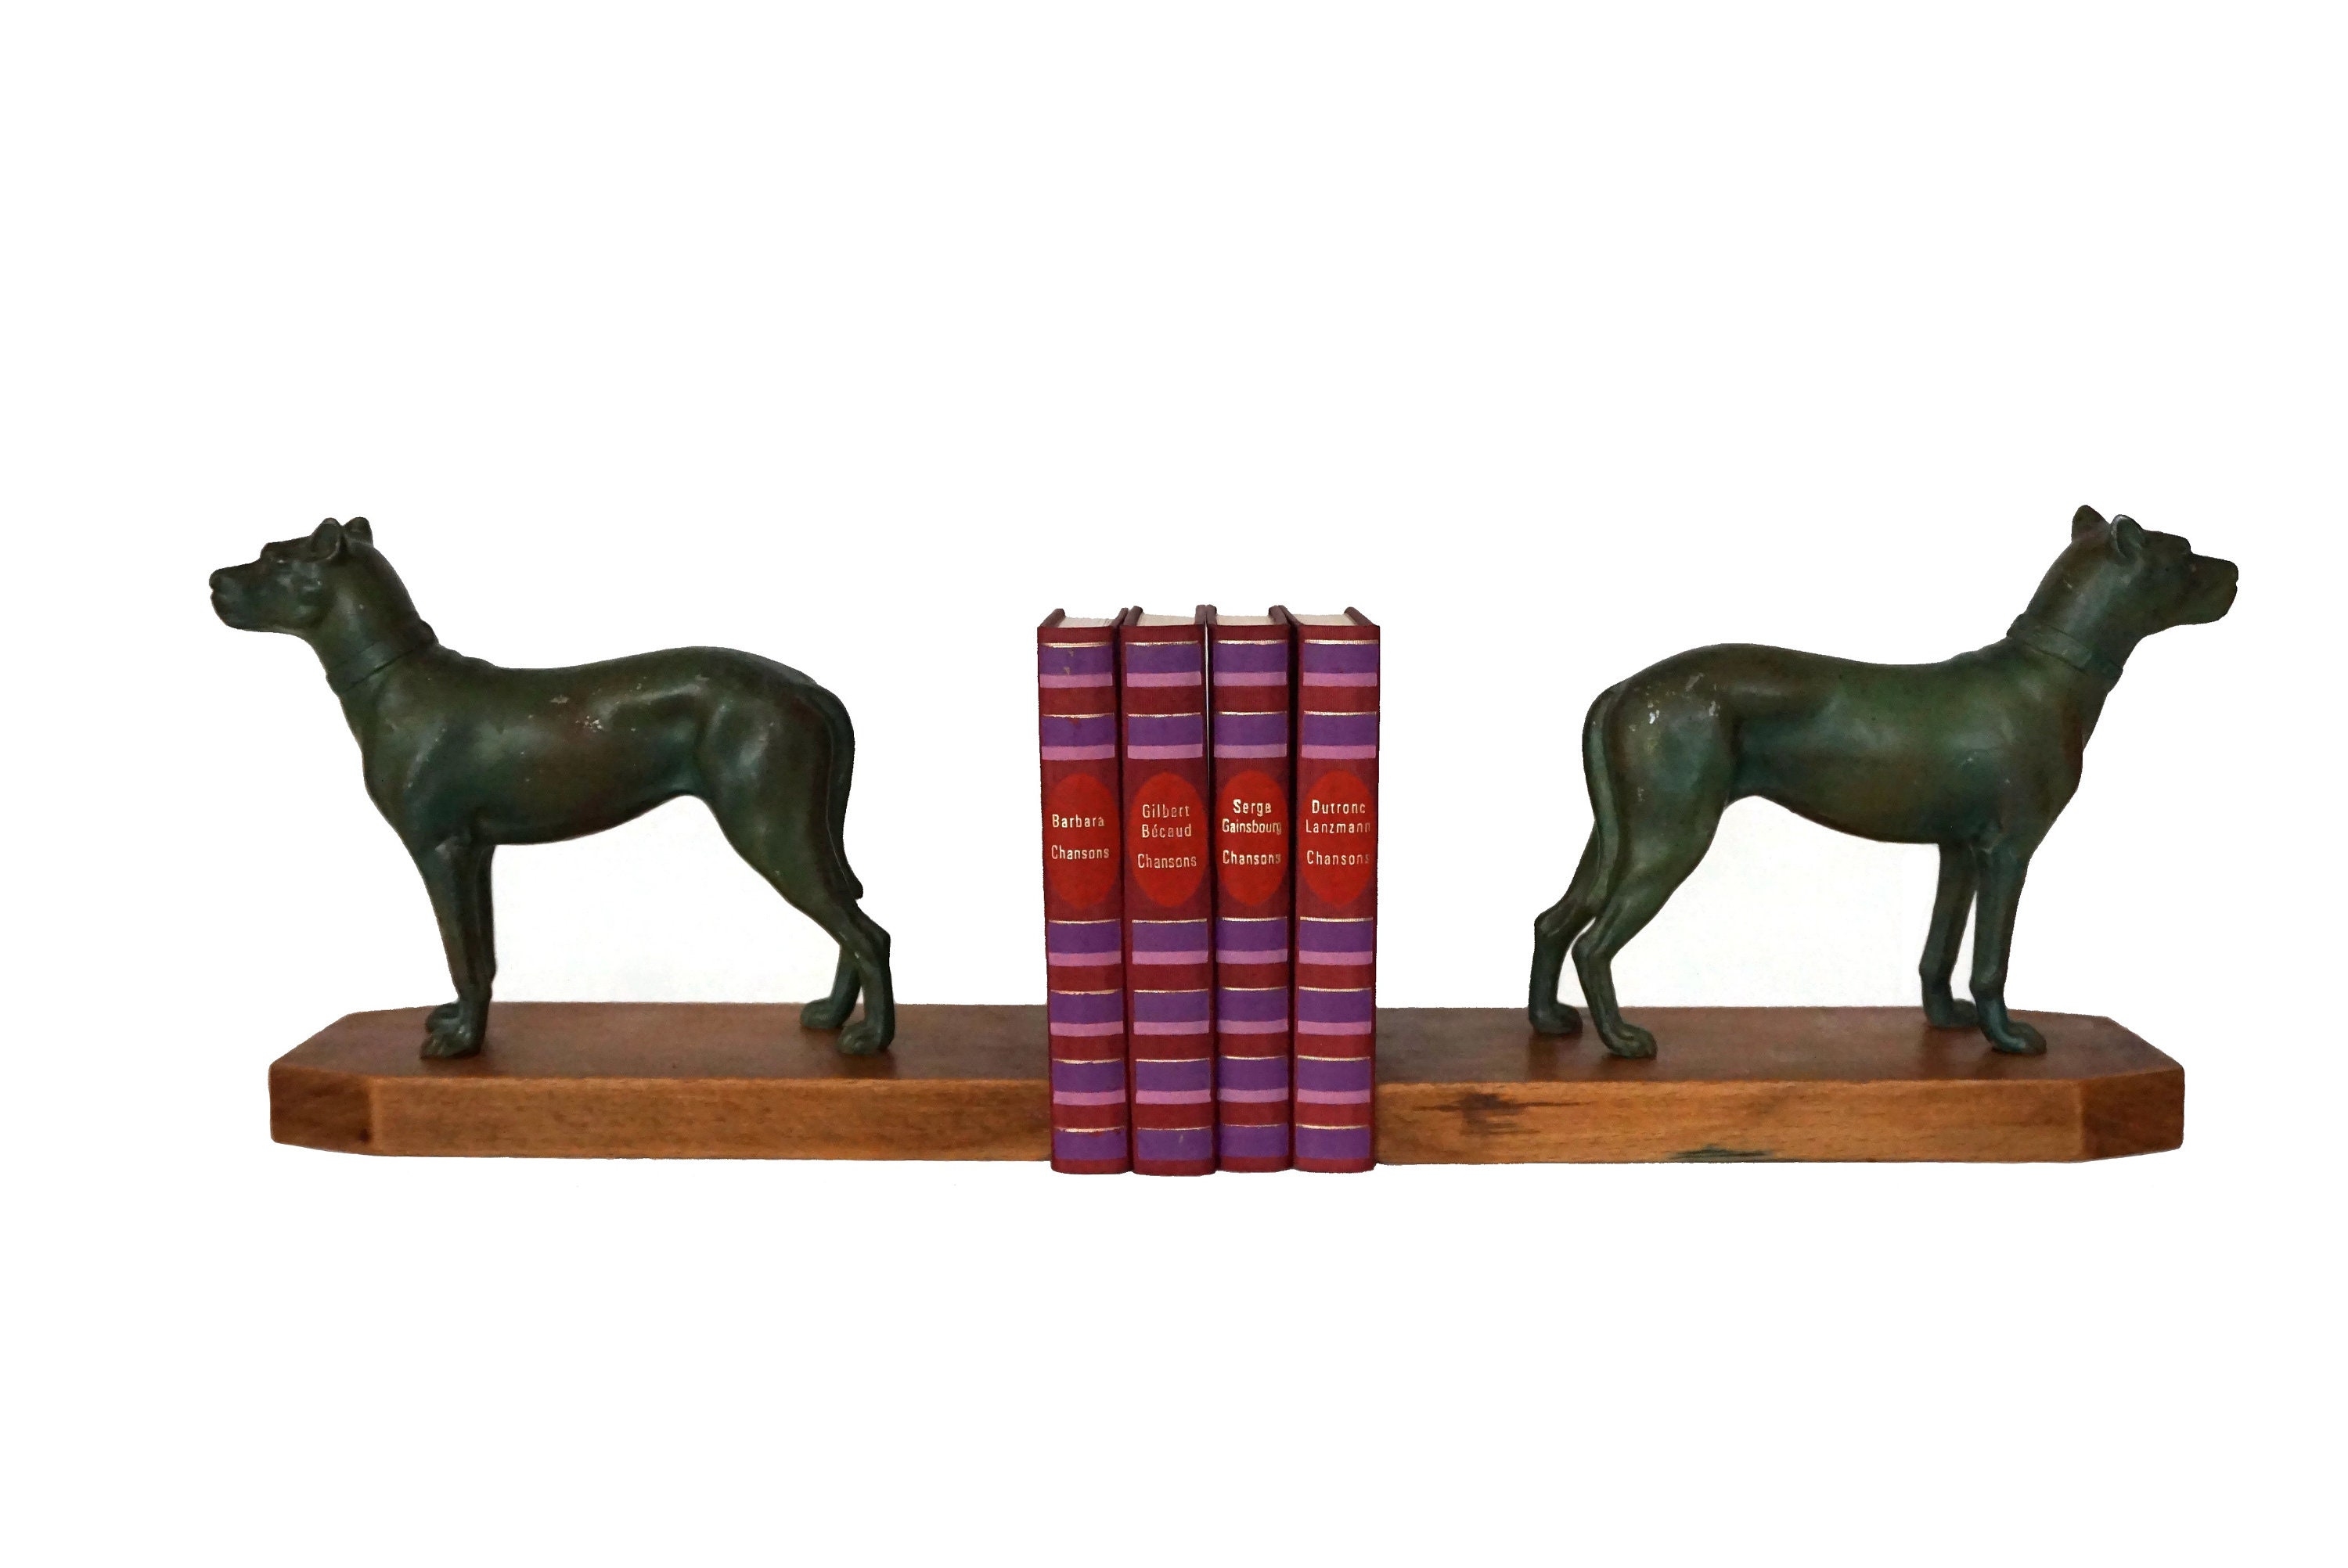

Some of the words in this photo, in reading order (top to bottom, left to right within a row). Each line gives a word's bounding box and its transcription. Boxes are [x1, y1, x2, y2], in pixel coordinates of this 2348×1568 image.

[1142, 804, 1190, 818] Gilbert
[1233, 799, 1272, 817] Serge
[1312, 800, 1366, 815] Dutronc
[1052, 814, 1105, 828] Barbara
[1222, 818, 1282, 836] Gainsbourg
[1305, 819, 1370, 834] Lanzmann
[1141, 824, 1192, 838] Bécaud
[1051, 845, 1110, 860] Chansons
[1223, 850, 1281, 865] Chansons
[1306, 850, 1370, 865] Chansons
[1137, 854, 1197, 869] Chansons
